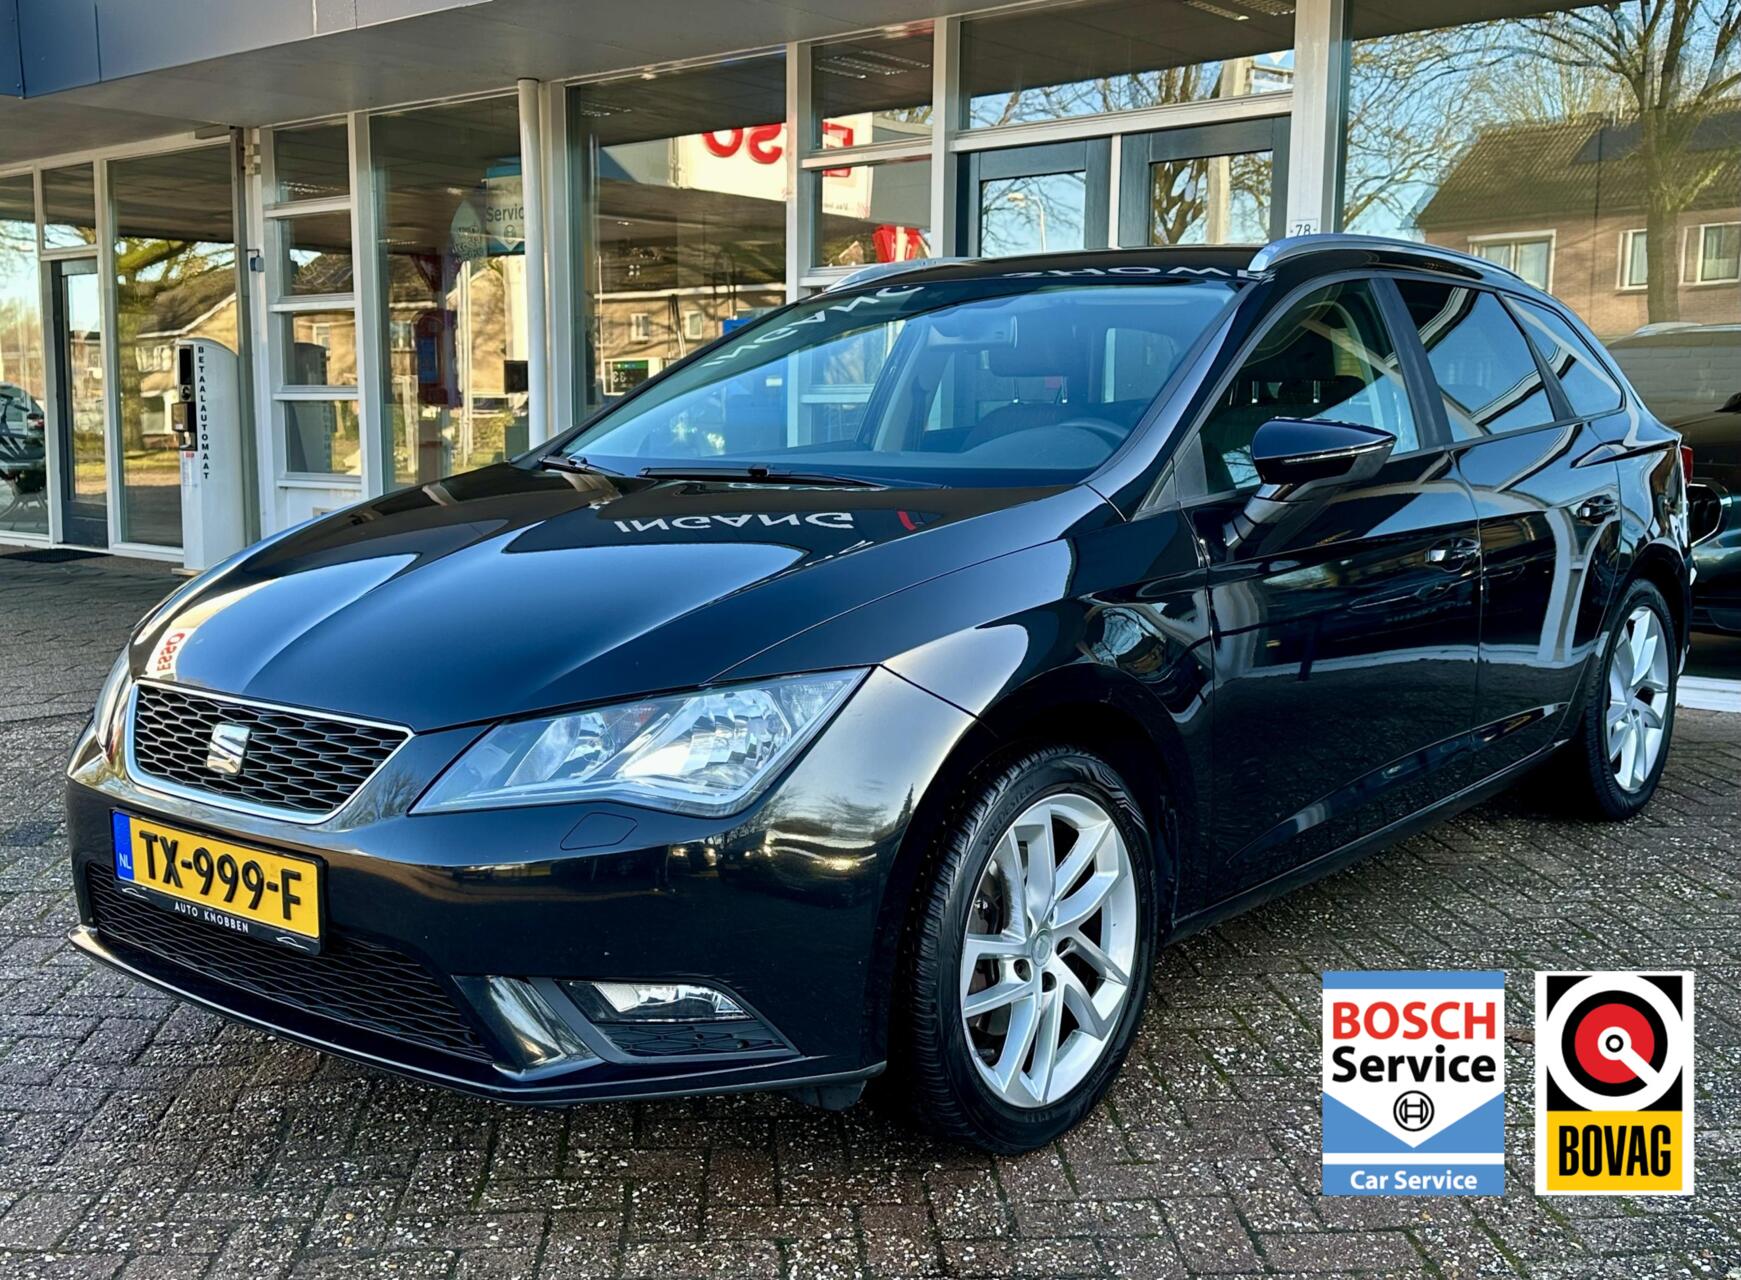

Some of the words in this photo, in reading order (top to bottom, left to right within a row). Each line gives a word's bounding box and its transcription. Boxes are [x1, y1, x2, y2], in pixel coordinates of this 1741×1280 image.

[486, 203, 525, 222] Servic
[1295, 224, 1312, 237] 78
[198, 346, 210, 480] BETAALAUTOMAAT
[118, 853, 132, 870] NL
[139, 829, 302, 921] TX-999-F
[174, 901, 199, 917] AUTO
[203, 909, 250, 934] KNOBBEN
